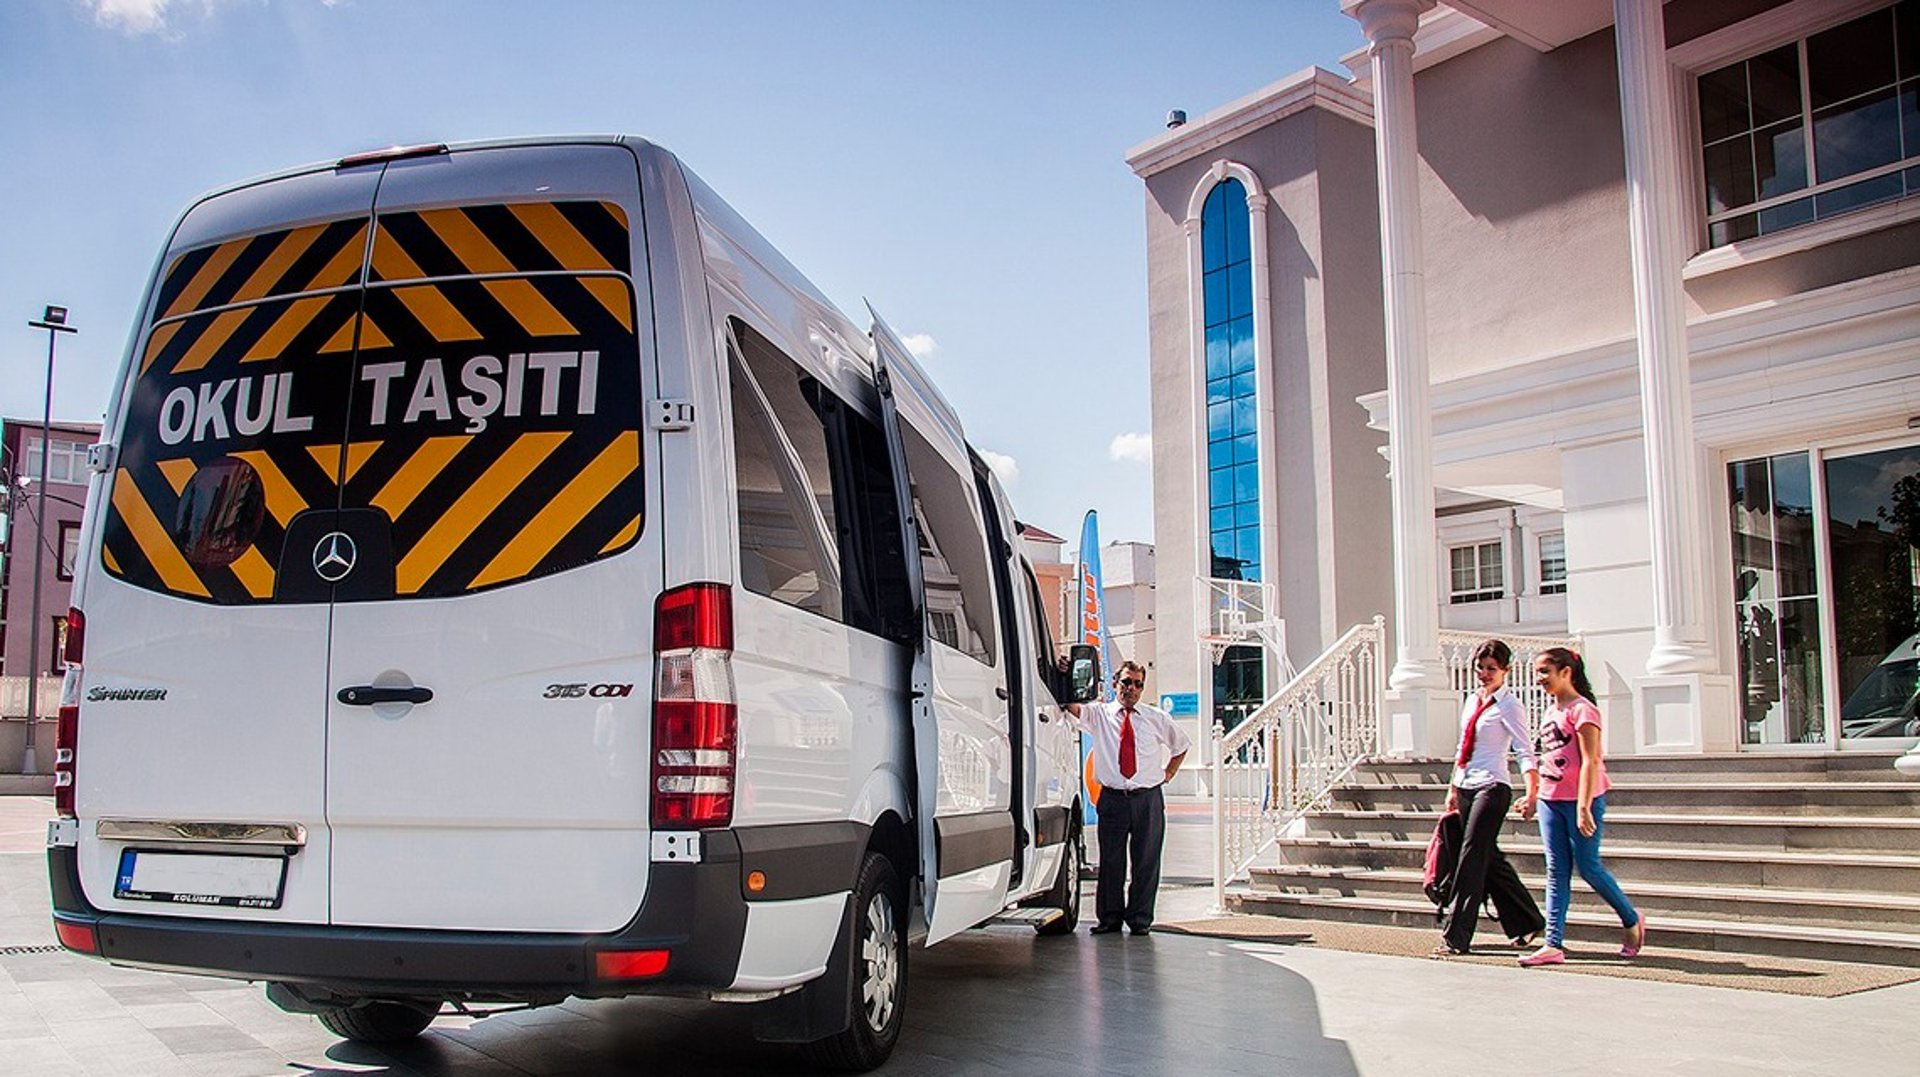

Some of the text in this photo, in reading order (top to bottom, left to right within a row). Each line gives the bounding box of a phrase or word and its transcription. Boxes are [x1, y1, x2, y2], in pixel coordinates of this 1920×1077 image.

[158, 350, 600, 446] OKUL TAŞITI
[542, 683, 634, 699] 315 CDI
[172, 893, 222, 905] KOLUMAN
